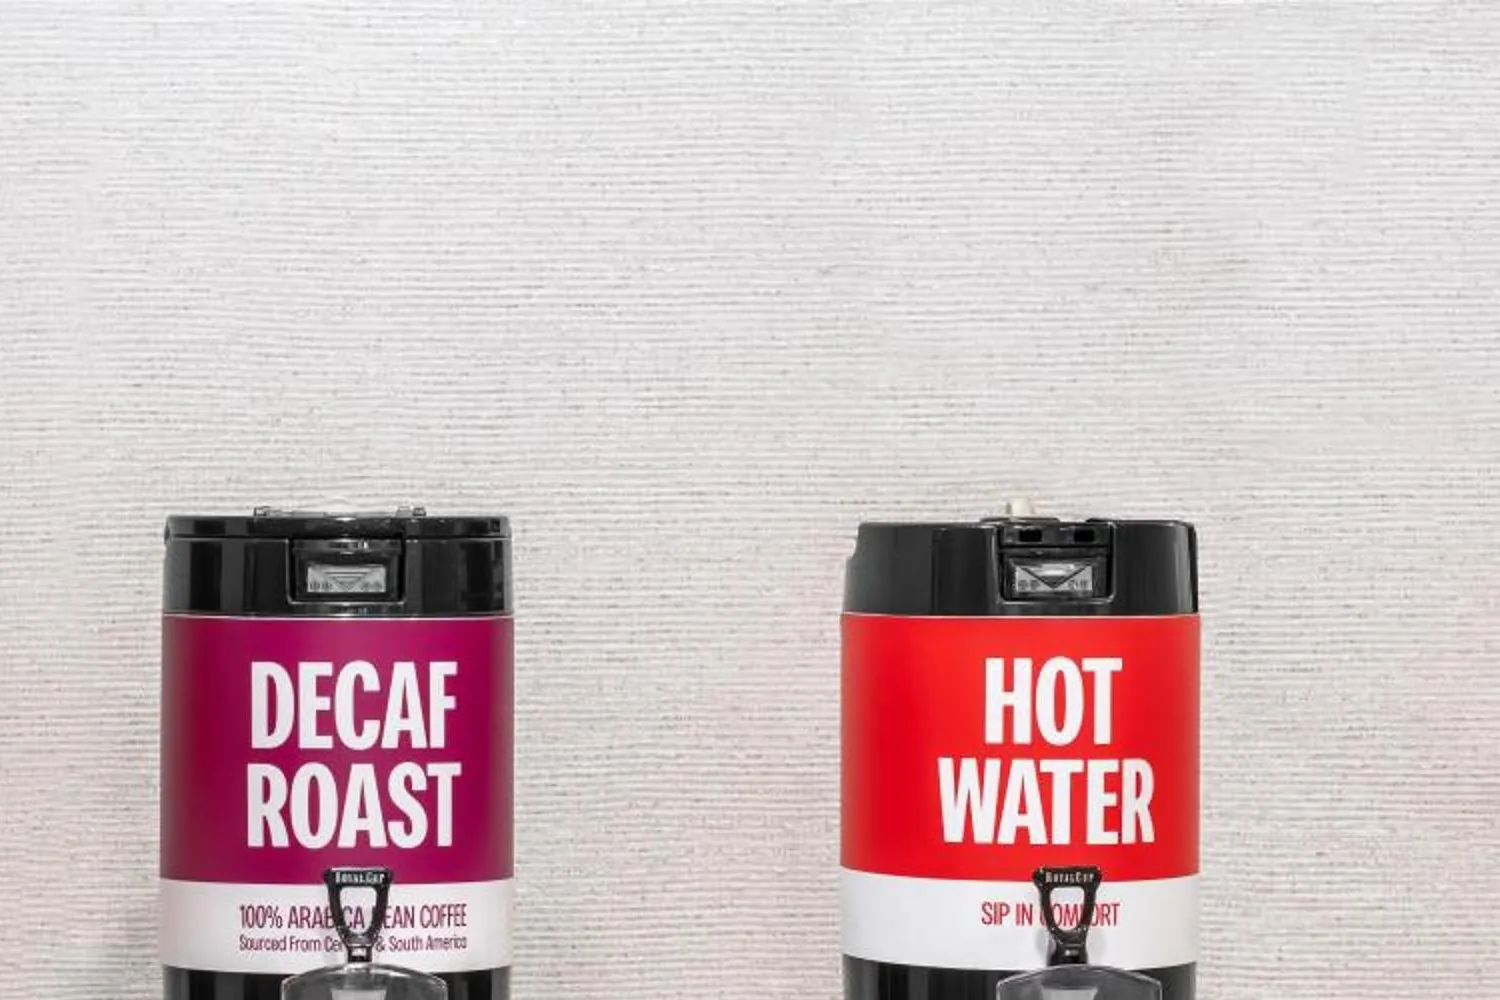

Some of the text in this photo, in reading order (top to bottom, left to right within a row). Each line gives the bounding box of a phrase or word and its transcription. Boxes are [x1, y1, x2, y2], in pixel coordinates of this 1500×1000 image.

[252, 660, 457, 750] DECAF
[985, 656, 1122, 746] HOT
[247, 761, 462, 849] ROAST
[938, 757, 1155, 845] WATER
[239, 903, 467, 929] 100% ARABCA EAN COFFEE
[239, 933, 287, 951] Sourced
[289, 935, 321, 953] From
[375, 936, 386, 952] &
[389, 935, 423, 952] South
[426, 933, 468, 951] America
[981, 901, 1010, 925] SIP
[1015, 902, 1033, 926] IN
